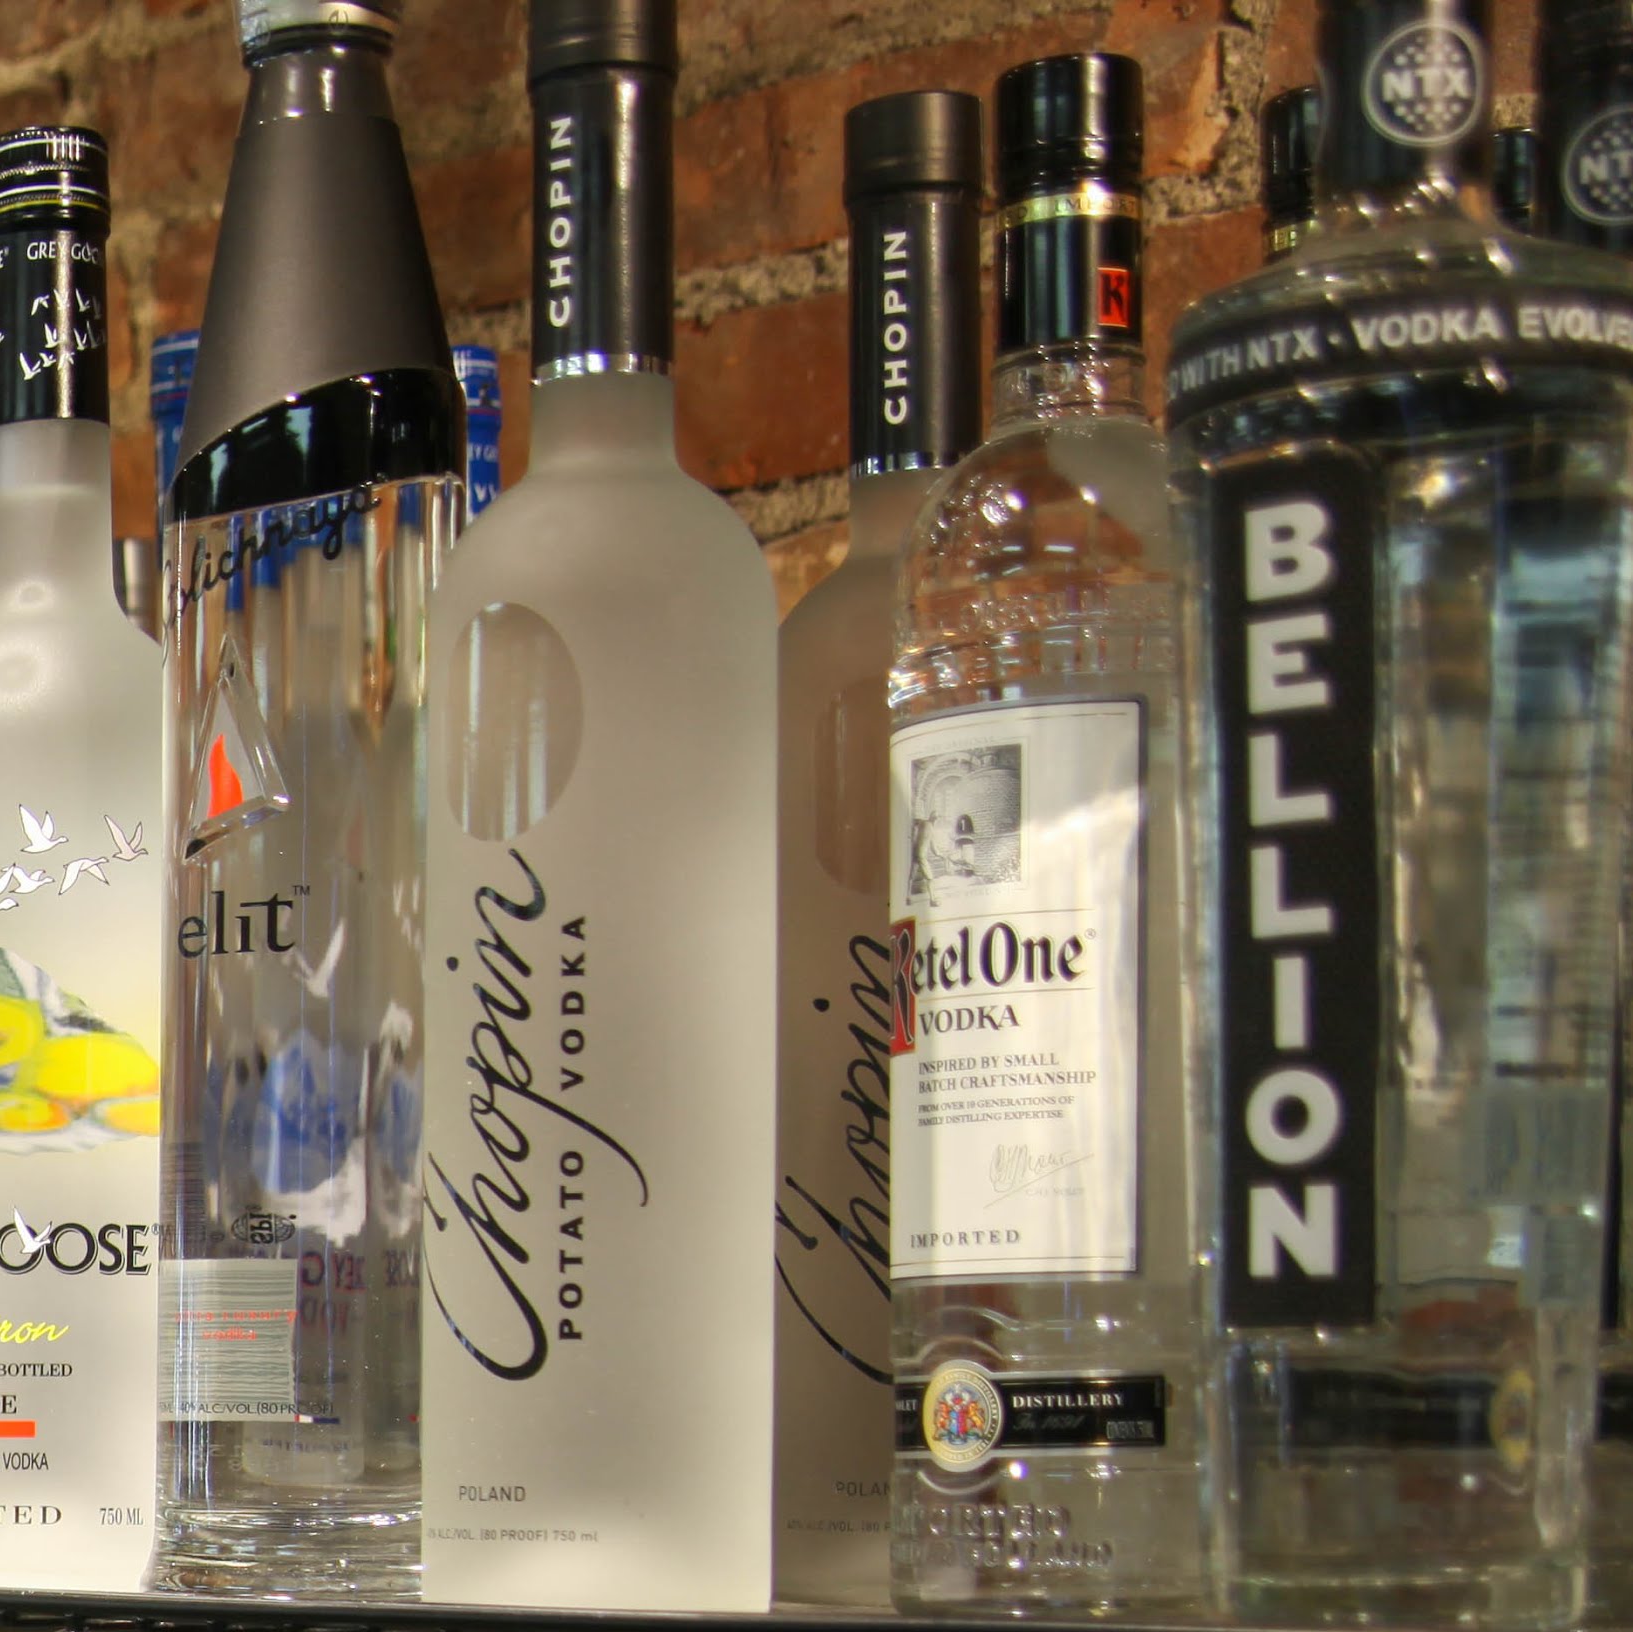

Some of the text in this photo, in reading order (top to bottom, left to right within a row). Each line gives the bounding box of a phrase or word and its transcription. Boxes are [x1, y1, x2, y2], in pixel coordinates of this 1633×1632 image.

[1383, 66, 1470, 99] NTX
[549, 115, 573, 328] CHOPIN
[884, 231, 908, 425] CHOPIN
[1247, 328, 1318, 369] NTX
[1352, 307, 1499, 350] VODKA
[1518, 306, 1633, 347] EVOLVE
[1244, 500, 1343, 1280] BELLION
[177, 891, 295, 959] elit
[979, 921, 1085, 988] One
[919, 1003, 1021, 1037] VODKA
[981, 1055, 1000, 1070] BY
[1004, 1052, 1060, 1068] SMALL
[918, 1070, 1097, 1094] BATCH CRAFTSMANSHIP
[559, 915, 587, 1341] POTATO VODKA
[910, 1229, 1021, 1249] IMPORTED
[1012, 1392, 1126, 1409] DISTILLERY
[3, 1451, 50, 1471] VODKA
[458, 1485, 527, 1503] POLAND
[99, 1506, 123, 1526] 750
[125, 1507, 144, 1525] ML
